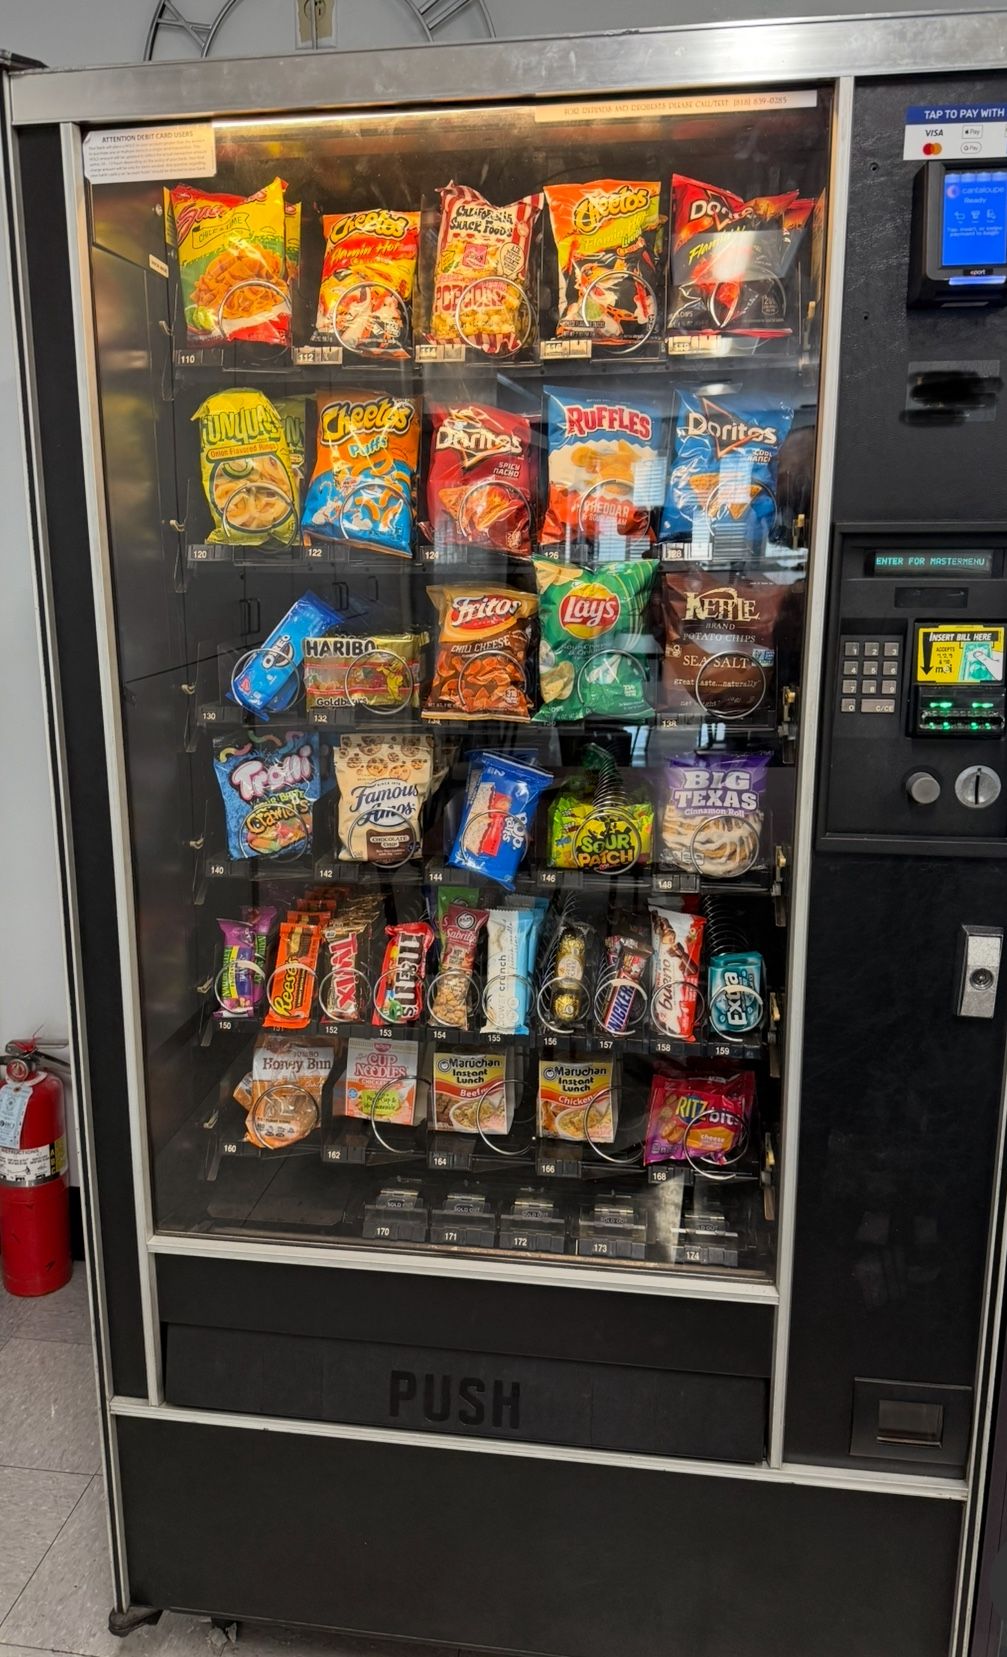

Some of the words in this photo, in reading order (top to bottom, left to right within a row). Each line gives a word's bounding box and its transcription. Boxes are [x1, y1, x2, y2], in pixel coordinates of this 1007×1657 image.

[924, 110, 943, 120] TAP
[945, 110, 957, 119] TO
[960, 109, 979, 118] PAY
[981, 108, 1005, 117] WITH
[102, 135, 135, 144] ATTENTION
[137, 133, 154, 141] DEBIT
[155, 132, 173, 140] CARD
[174, 130, 193, 138] USERS
[962, 186, 1004, 195] cantaloupe
[575, 186, 649, 235] Cheetos
[330, 208, 409, 244] Cheetos
[450, 216, 482, 234] SNACK
[483, 223, 513, 238] FOODS
[180, 354, 195, 364] 110
[299, 353, 313, 362] 112
[322, 397, 411, 442] Cheetos
[566, 405, 651, 440] RUFFLES
[688, 412, 778, 444] Doritos
[436, 427, 522, 454] Doritos
[211, 449, 229, 458] Onion
[229, 446, 257, 456] Flavored
[259, 443, 276, 453] Rings
[349, 436, 388, 458] Puffs
[499, 461, 521, 470] SPICY
[493, 467, 519, 478] NACHO
[584, 500, 630, 518] CHEDDAR
[193, 550, 207, 559] 120
[308, 549, 322, 557] 122
[425, 551, 439, 560] 124
[667, 549, 682, 558] 128
[875, 557, 903, 566] ENTER
[908, 557, 926, 566] FOR
[930, 557, 985, 566] MASTERMENU
[682, 587, 760, 621] KETTLE
[452, 597, 521, 627] Fritos
[563, 596, 617, 627] Lay's
[706, 622, 736, 631] BRAND
[683, 633, 723, 642] POTATO
[726, 634, 756, 643] CHIPS
[929, 632, 954, 642] INSERT
[956, 633, 971, 642] BILL
[973, 632, 992, 641] HERE
[306, 639, 376, 657] HARIBO
[451, 643, 471, 654] CHILI
[474, 635, 511, 652] CHEESE
[262, 634, 291, 669] OREO
[682, 655, 707, 667] SEA
[714, 657, 749, 669] SALT
[203, 712, 216, 721] 130
[314, 715, 327, 723] 132
[662, 720, 677, 728] 138
[231, 745, 312, 801] Trolli
[684, 770, 750, 790] BIG
[350, 784, 419, 813] Famous
[675, 789, 757, 811] TEXAS
[247, 799, 309, 834] Crawlers
[357, 803, 415, 826] Amos
[685, 808, 727, 816] Cinnamon
[728, 808, 744, 818] Roll
[581, 833, 630, 853] SOUR
[578, 848, 634, 868] PATCH
[211, 866, 224, 875] 140
[320, 870, 333, 878] 142
[429, 873, 443, 881] 144
[542, 873, 556, 882] 146
[658, 880, 672, 889] 148
[329, 931, 358, 1010] TWIX
[498, 954, 507, 992] crunch
[658, 959, 673, 1011] bueno
[607, 985, 635, 1032] NICKER
[219, 1022, 232, 1030] 150
[325, 1026, 338, 1034] 152
[433, 1031, 446, 1039] 154
[544, 1038, 557, 1046] 156
[600, 1041, 613, 1049] 157
[656, 1044, 671, 1052] 158
[715, 1047, 730, 1055] 159
[367, 1052, 398, 1067] CUP
[449, 1058, 500, 1068] Maruchan
[263, 1058, 304, 1073] Honey
[307, 1058, 331, 1070] Bun
[354, 1063, 407, 1077] NOODLES
[453, 1069, 488, 1077] Instant
[555, 1066, 607, 1076] Maruchan
[558, 1077, 594, 1085] Instant
[460, 1088, 481, 1098] Beef
[558, 1095, 594, 1106] Chicken
[675, 1096, 708, 1119] RITZ
[700, 1134, 725, 1142] cheese
[224, 1144, 237, 1152] 160
[327, 1151, 341, 1159] 162
[433, 1158, 447, 1166] 164
[542, 1165, 555, 1173] 166
[652, 1172, 667, 1181] 168
[377, 1228, 390, 1237] 170
[445, 1232, 457, 1241] 171
[514, 1238, 527, 1247] 172
[594, 1243, 607, 1253] 173
[686, 1251, 700, 1260] 174
[389, 1370, 520, 1429] PUSH
